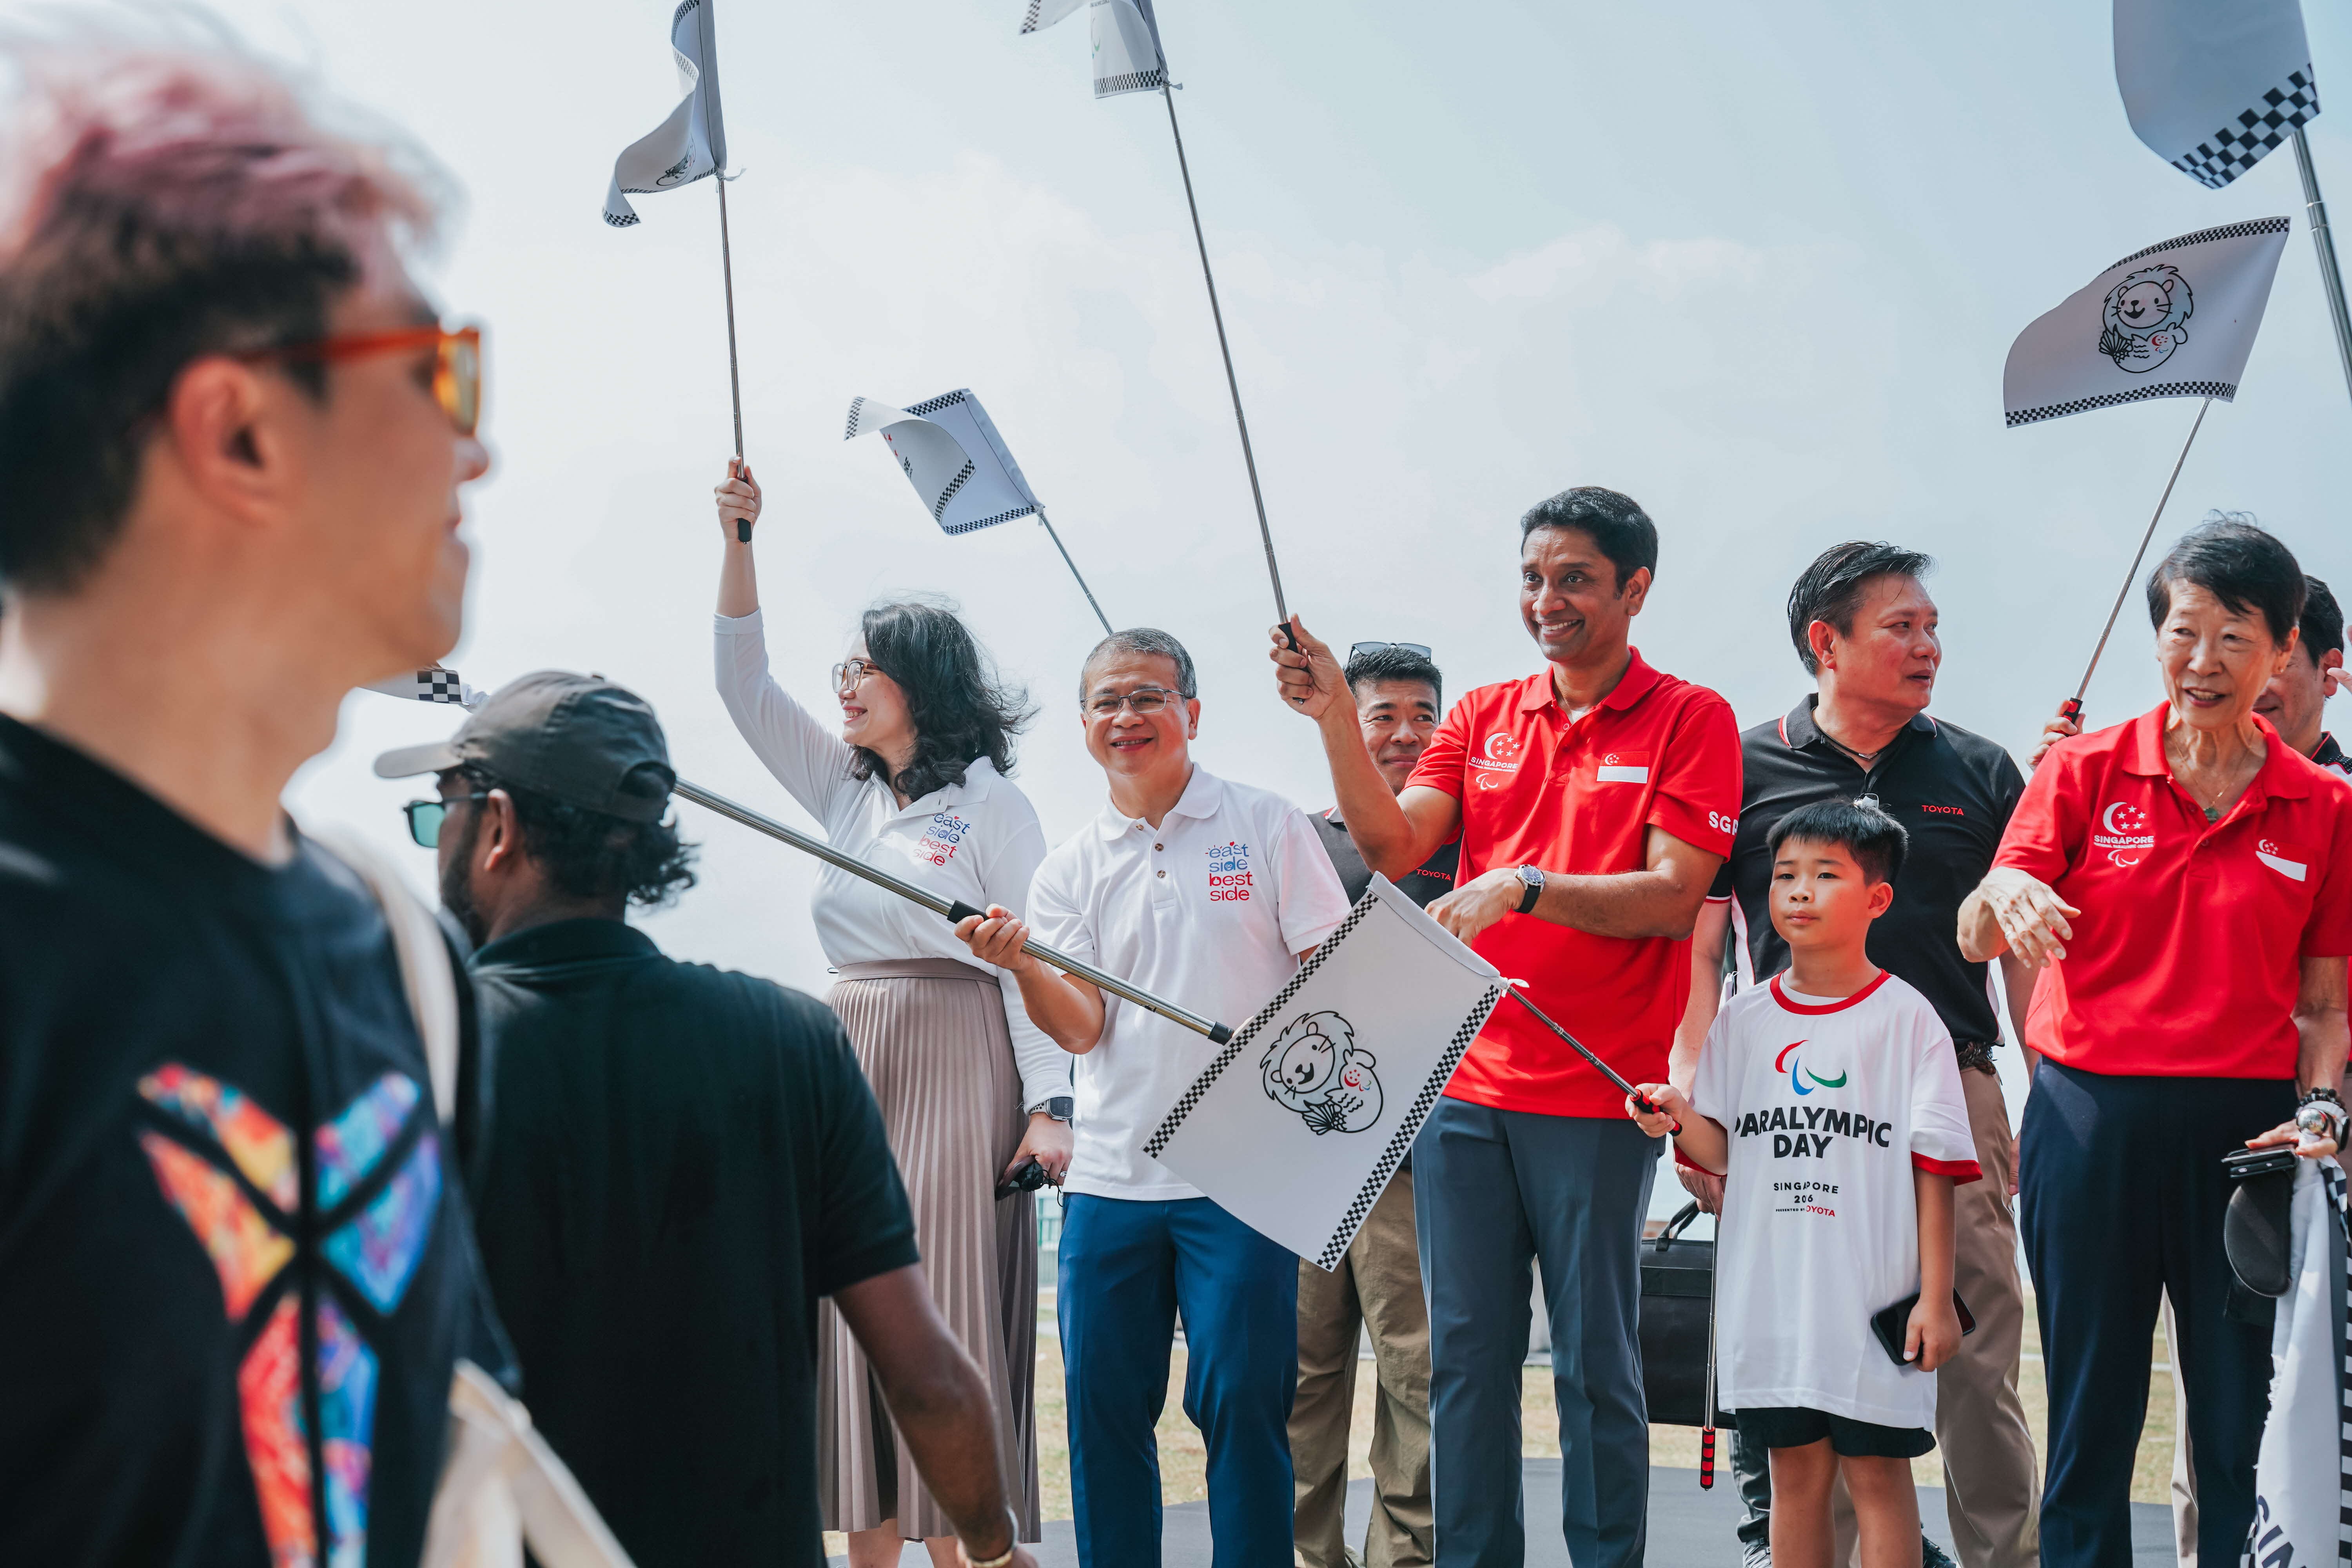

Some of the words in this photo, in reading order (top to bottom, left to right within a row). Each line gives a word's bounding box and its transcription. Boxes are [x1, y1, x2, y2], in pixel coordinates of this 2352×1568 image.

[1471, 757, 1518, 769] SINGAPORE
[1922, 805, 1964, 815] TOYOTA
[934, 813, 970, 834] east
[926, 825, 960, 843] side
[2094, 835, 2154, 844] SINGAPORE
[918, 834, 956, 858] best
[1209, 844, 1249, 858] east
[913, 849, 945, 866] side
[1209, 856, 1248, 872] side
[1209, 871, 1253, 886] best
[1417, 869, 1451, 880] TOYOTA
[1210, 886, 1250, 901] side
[1774, 1133, 1833, 1158] DAY
[1773, 1181, 1838, 1194] SINGAPORE
[1794, 1195, 1813, 1203] 206
[1806, 1205, 1835, 1217] OYOTA
